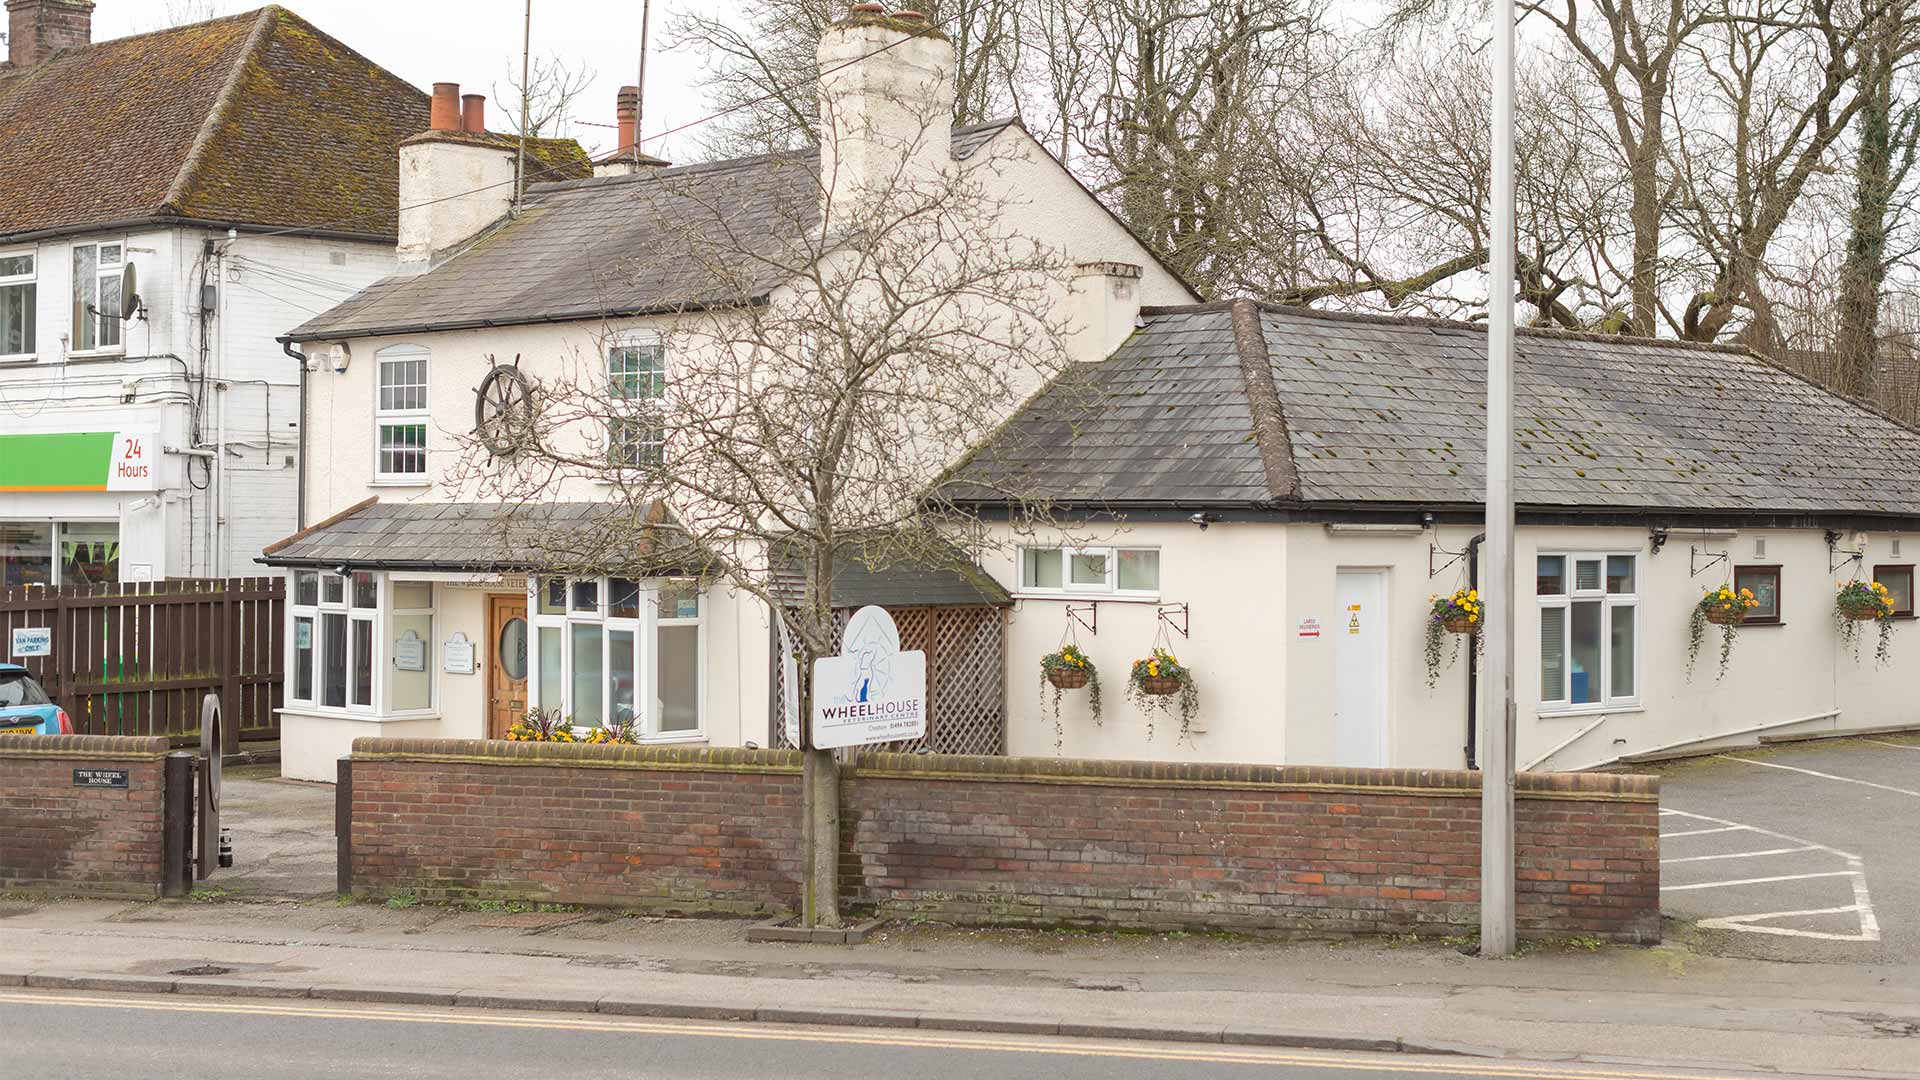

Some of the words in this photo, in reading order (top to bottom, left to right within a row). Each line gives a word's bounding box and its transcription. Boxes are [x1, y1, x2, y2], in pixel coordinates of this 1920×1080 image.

[125, 438, 141, 459] 24
[117, 461, 148, 478] Hours
[822, 699, 919, 720] WHEELHOUSE
[843, 713, 889, 724] VETERINARY
[891, 711, 919, 720] CENTRE
[88, 777, 112, 785] HOUSE
[95, 771, 122, 779] WHEEL
